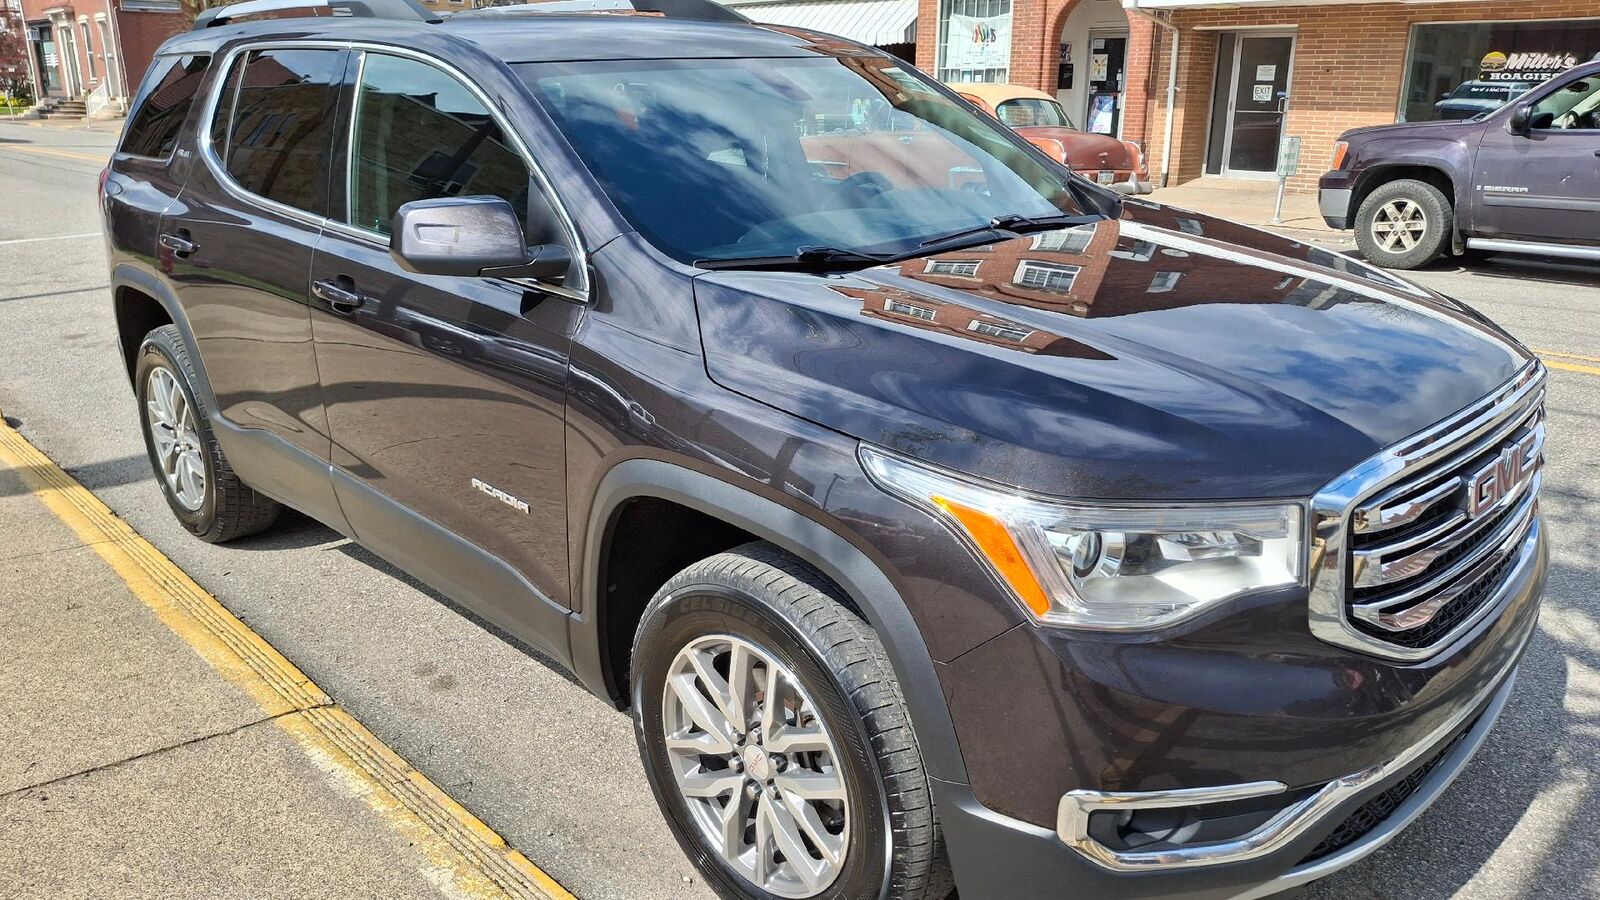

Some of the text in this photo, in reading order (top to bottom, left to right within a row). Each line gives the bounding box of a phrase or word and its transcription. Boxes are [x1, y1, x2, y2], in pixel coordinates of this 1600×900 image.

[1504, 52, 1576, 69] Miller's
[1254, 86, 1272, 95] EXIT
[1483, 185, 1529, 193] SIERRA
[1467, 421, 1546, 520] GMC
[471, 477, 530, 514] ACADIA
[748, 753, 763, 772] GMC
